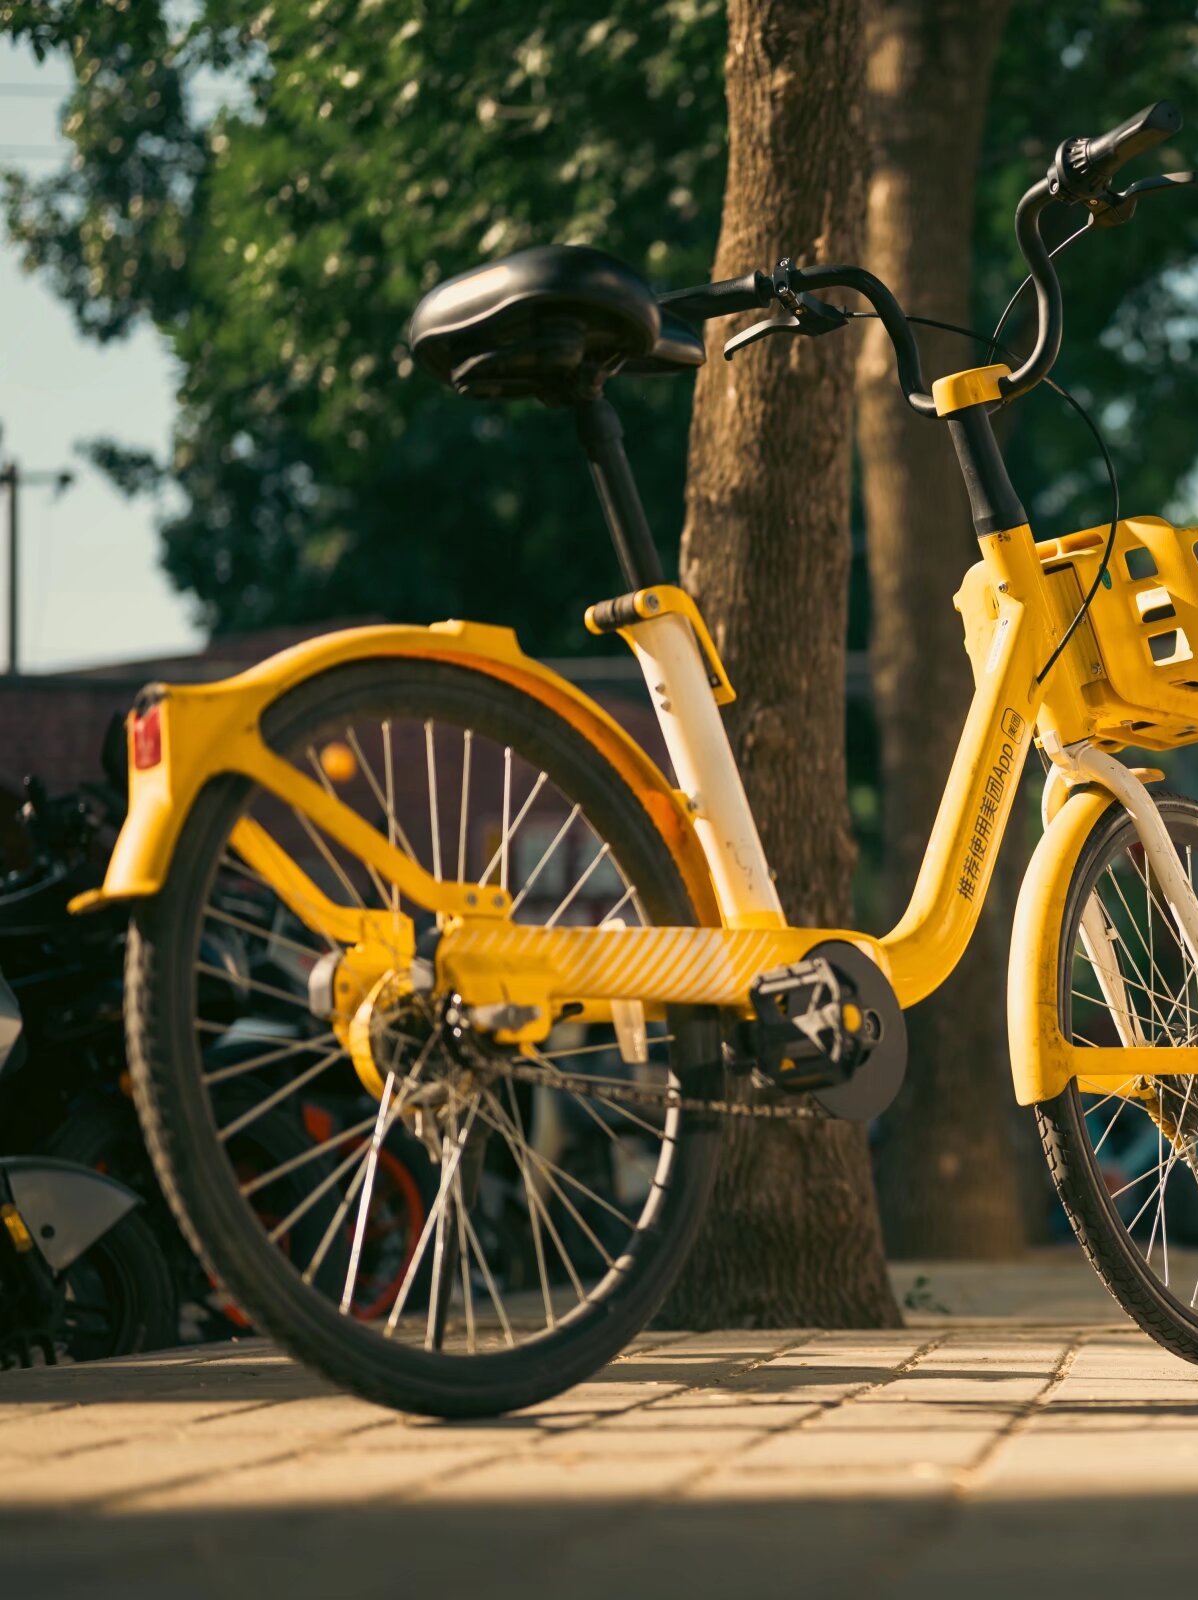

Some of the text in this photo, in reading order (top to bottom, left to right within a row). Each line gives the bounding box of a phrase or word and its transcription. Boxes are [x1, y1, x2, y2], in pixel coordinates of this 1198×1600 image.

[957, 743, 1014, 901] 推荐使用美团App
